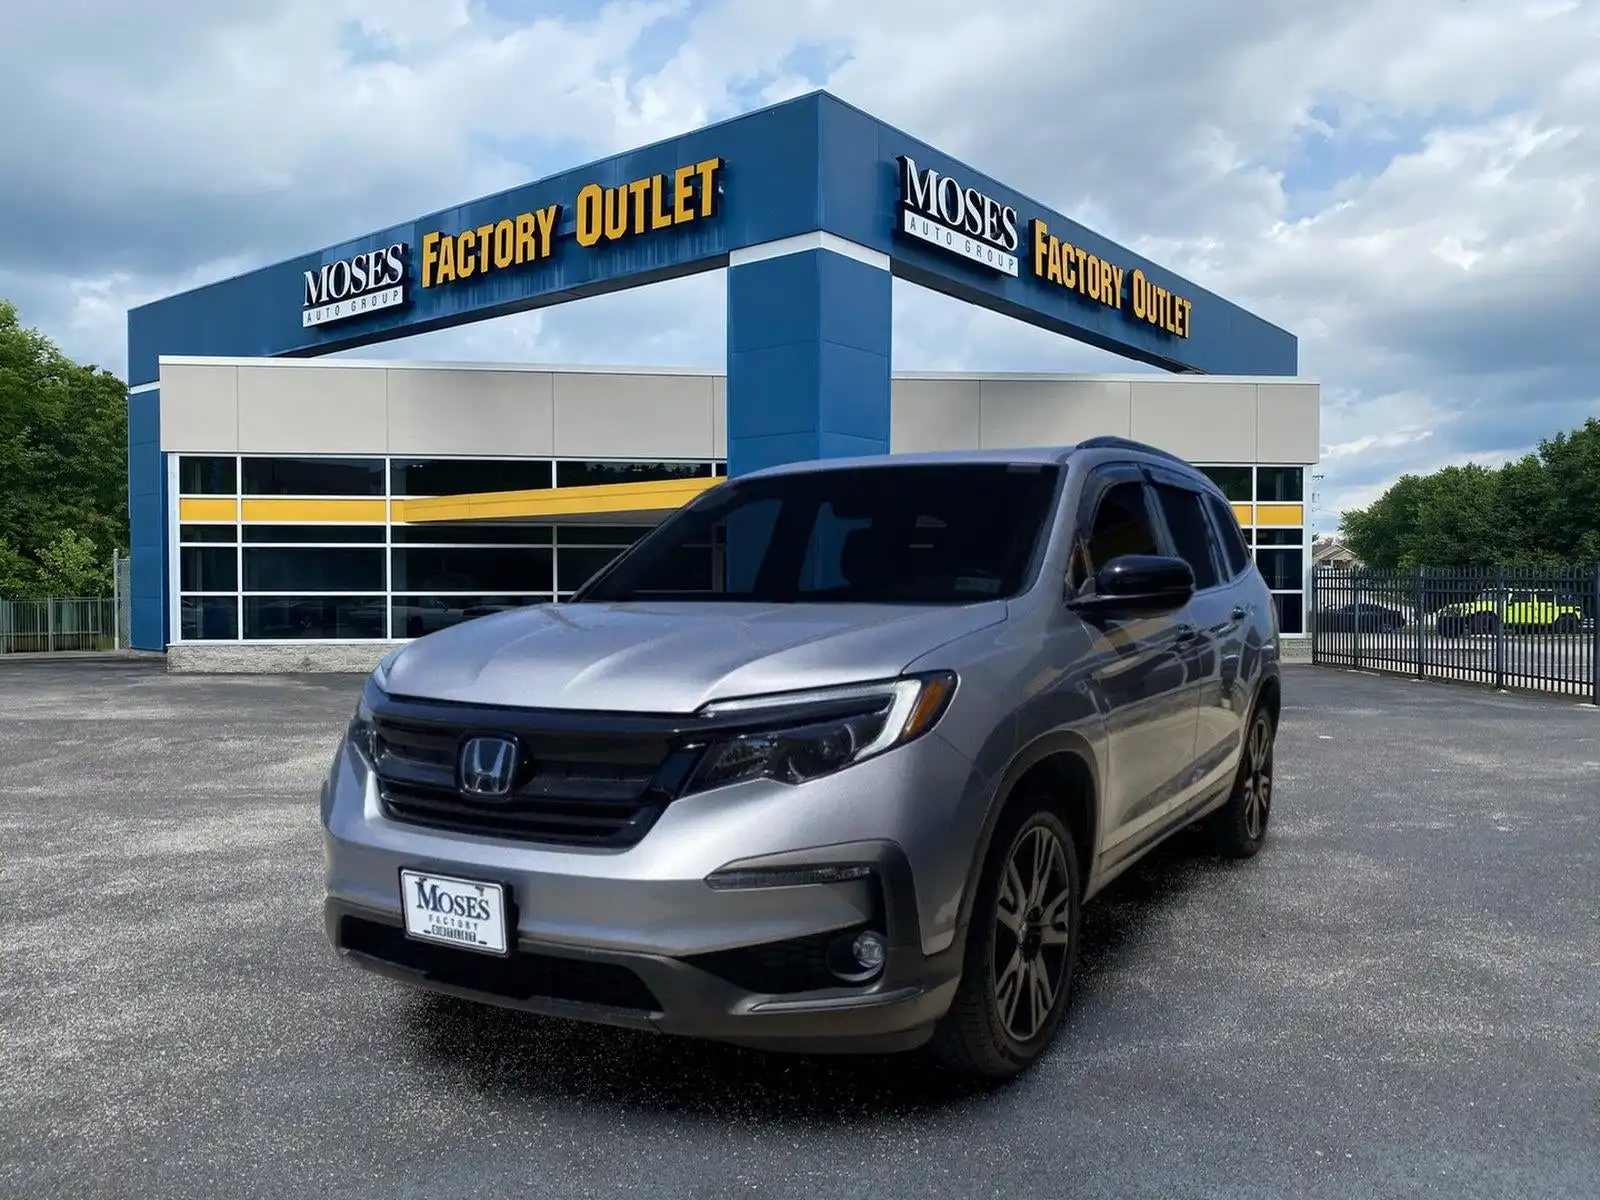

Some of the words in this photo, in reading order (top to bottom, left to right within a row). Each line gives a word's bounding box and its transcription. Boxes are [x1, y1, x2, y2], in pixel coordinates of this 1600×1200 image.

[421, 205, 559, 288] FACTORY
[576, 157, 720, 247] OUTLET
[904, 155, 1018, 251] MOSES
[909, 216, 953, 246] AUTO
[965, 239, 1015, 271] GROUP
[303, 243, 403, 306] MOSES
[1034, 218, 1124, 309] FACTORY
[1132, 267, 1192, 339] OUTLET
[307, 305, 340, 323] AUTO
[351, 290, 399, 312] GROUP
[415, 880, 490, 920] MOSES
[429, 914, 478, 931] FACTORY
